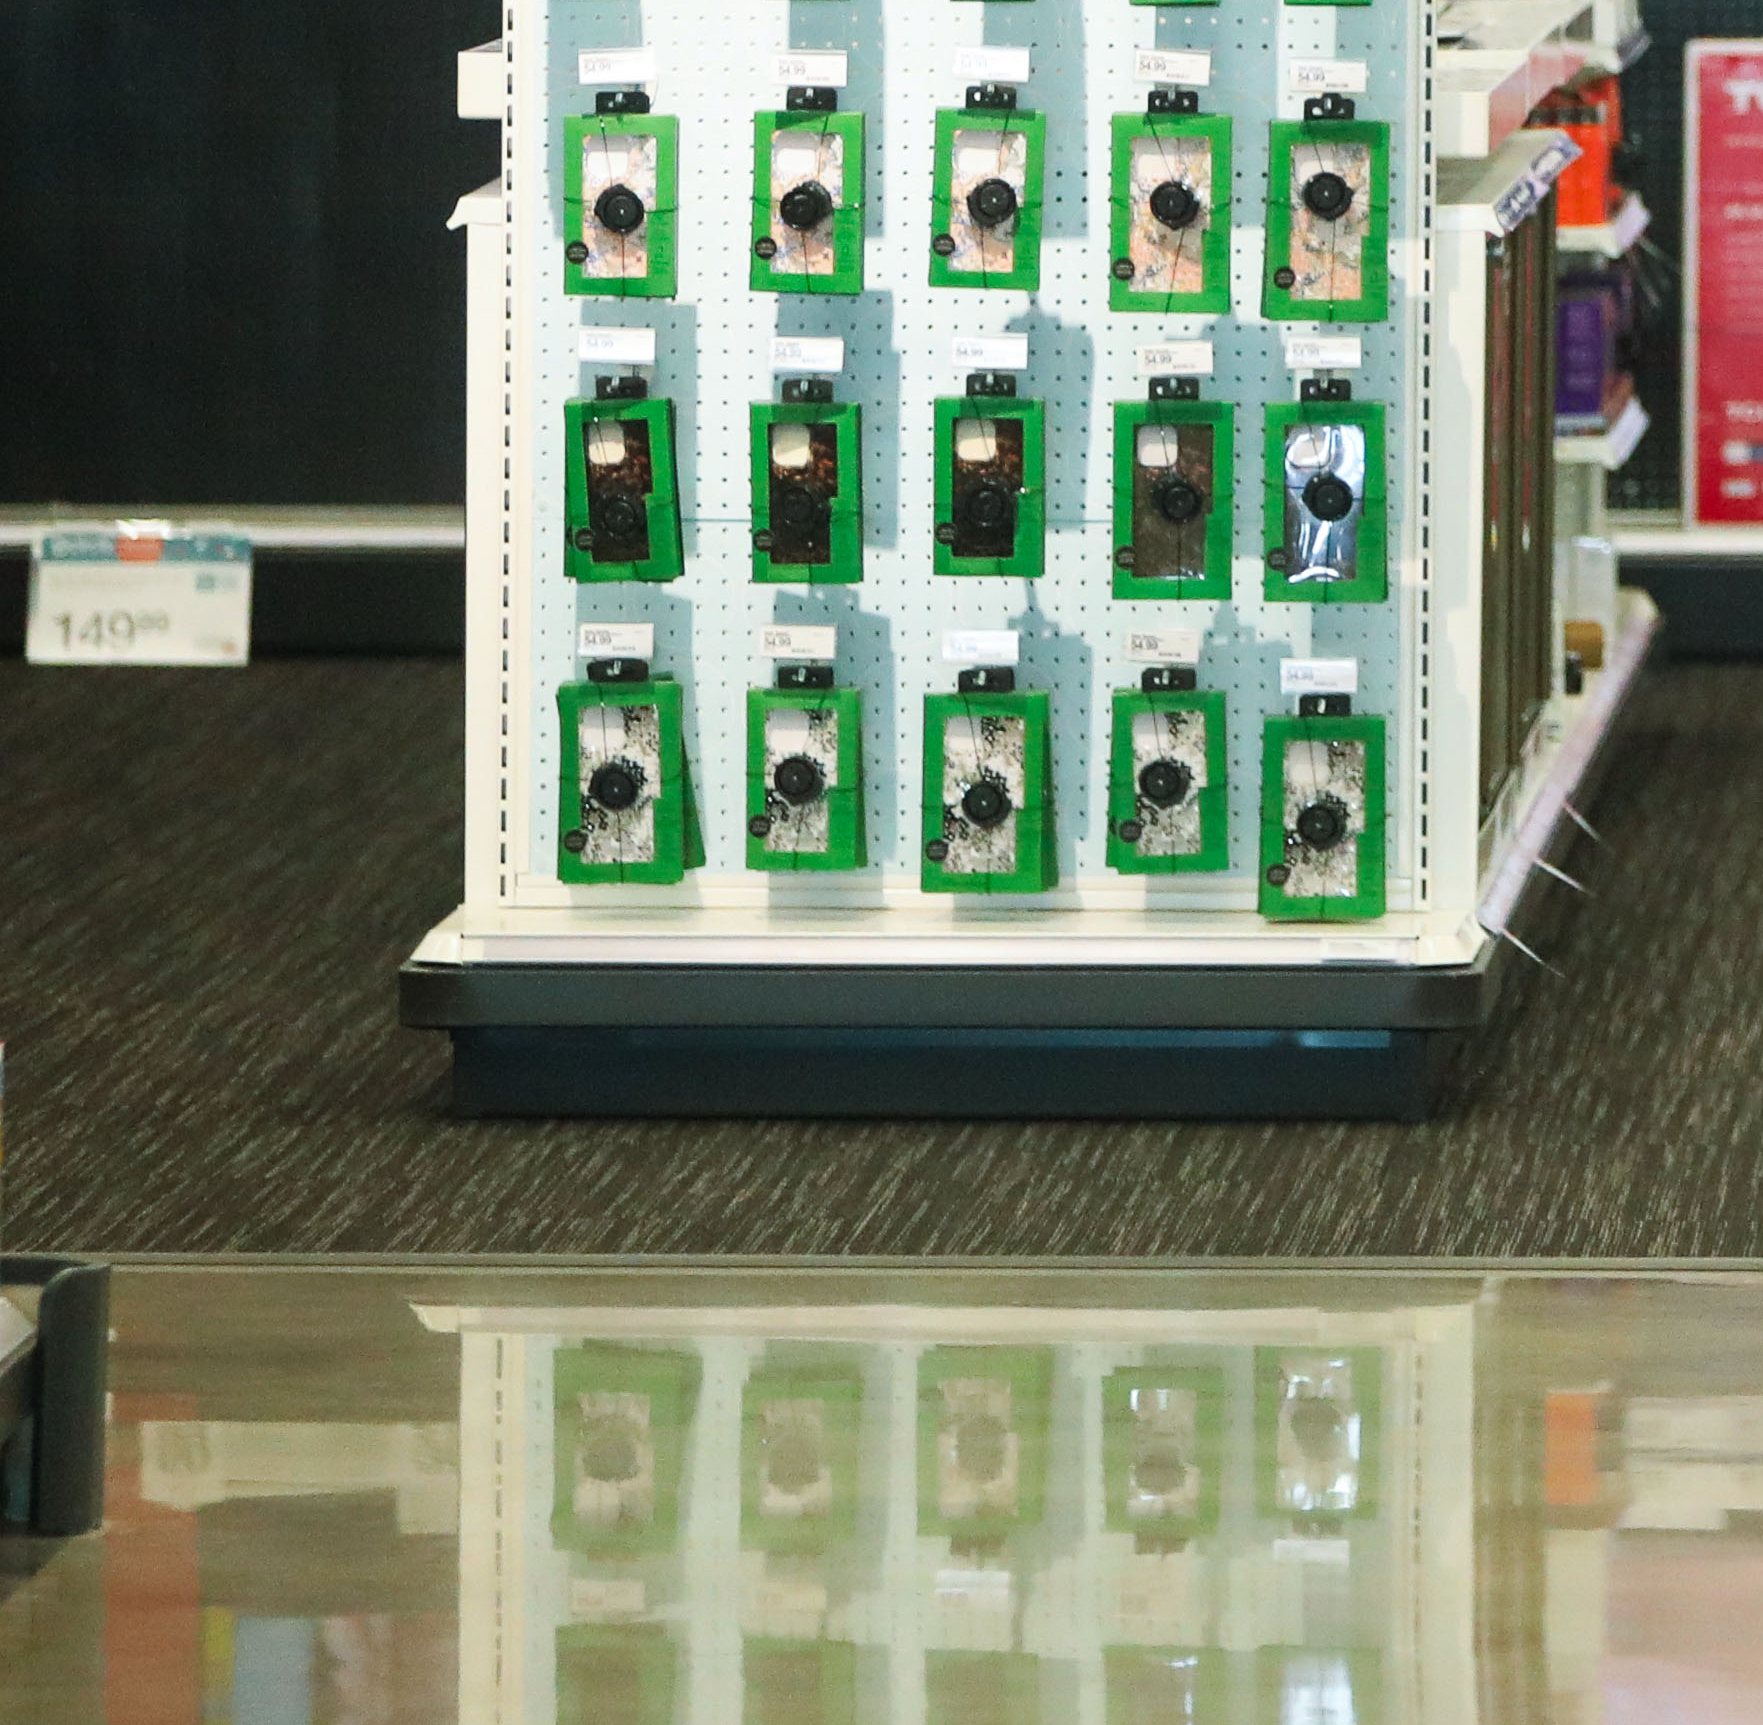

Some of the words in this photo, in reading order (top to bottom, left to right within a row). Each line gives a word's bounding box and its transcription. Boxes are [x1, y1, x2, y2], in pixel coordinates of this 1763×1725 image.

[778, 65, 806, 76] 54.99
[1138, 60, 1167, 72] 54.99
[1144, 353, 1172, 365] 54.99
